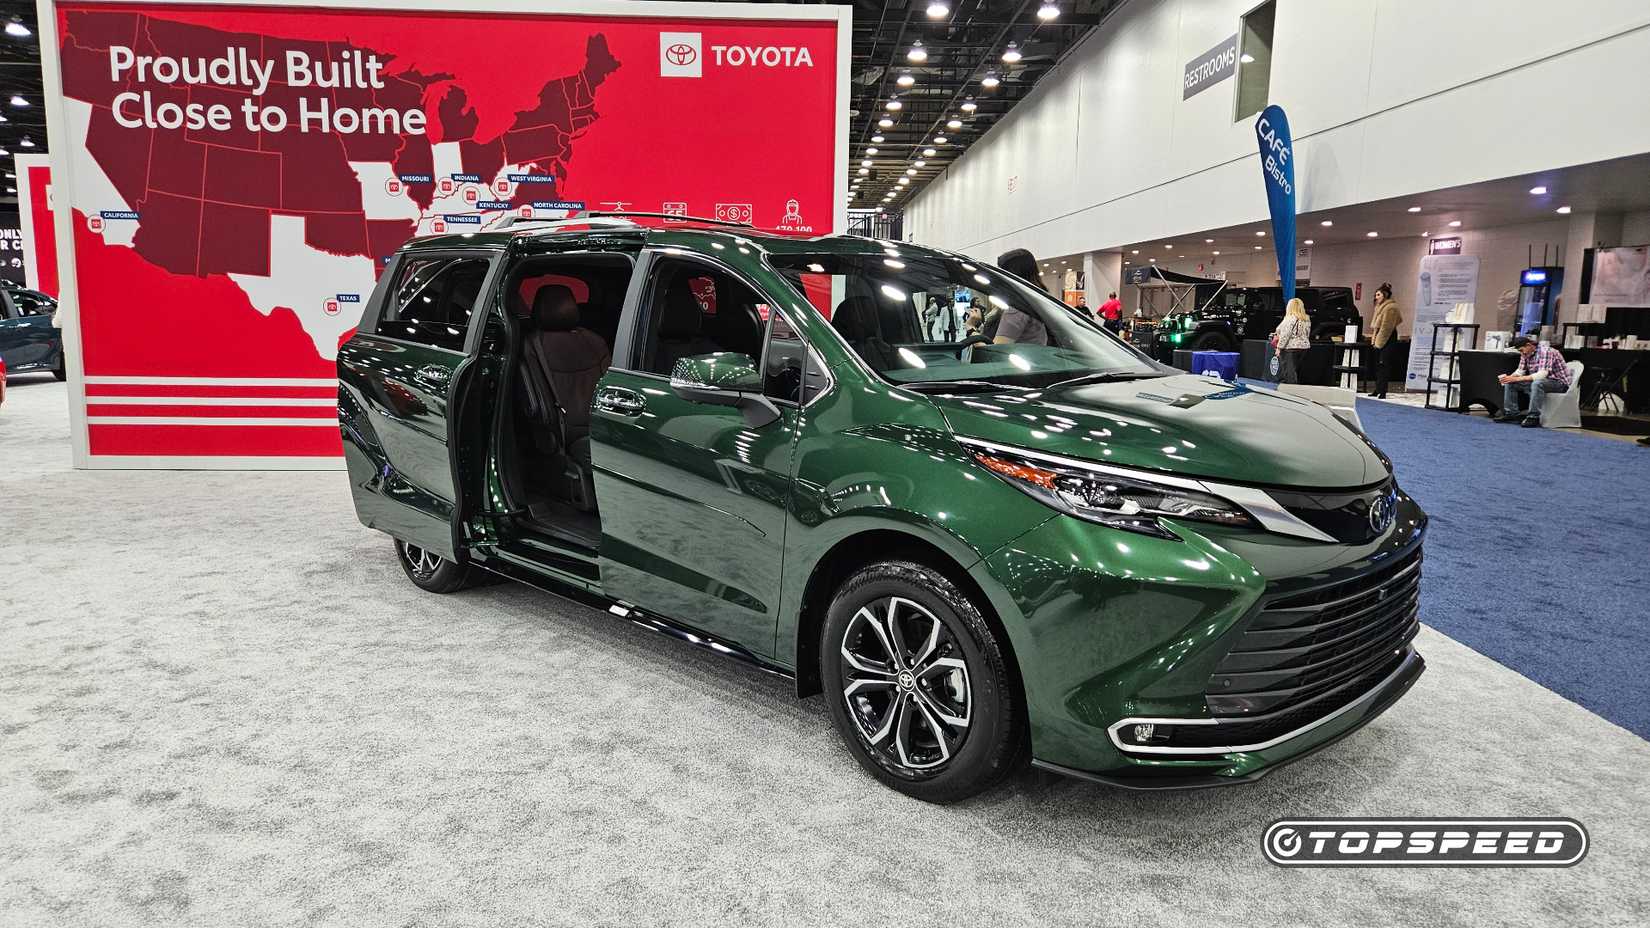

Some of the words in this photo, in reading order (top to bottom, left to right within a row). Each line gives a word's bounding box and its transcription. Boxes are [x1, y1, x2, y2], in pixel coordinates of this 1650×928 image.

[109, 46, 275, 95] Proudly
[286, 50, 385, 89] Built
[711, 45, 814, 67] TOYOTA
[1184, 46, 1236, 89] RESTROOMS
[112, 92, 232, 131] Close
[241, 98, 288, 133] to
[300, 97, 427, 135] Home
[401, 175, 430, 183] MISSOURI
[510, 175, 526, 183] WEST
[527, 175, 553, 183] VIRGINIA
[1265, 155, 1292, 195] Bistro
[533, 202, 553, 210] NORTH
